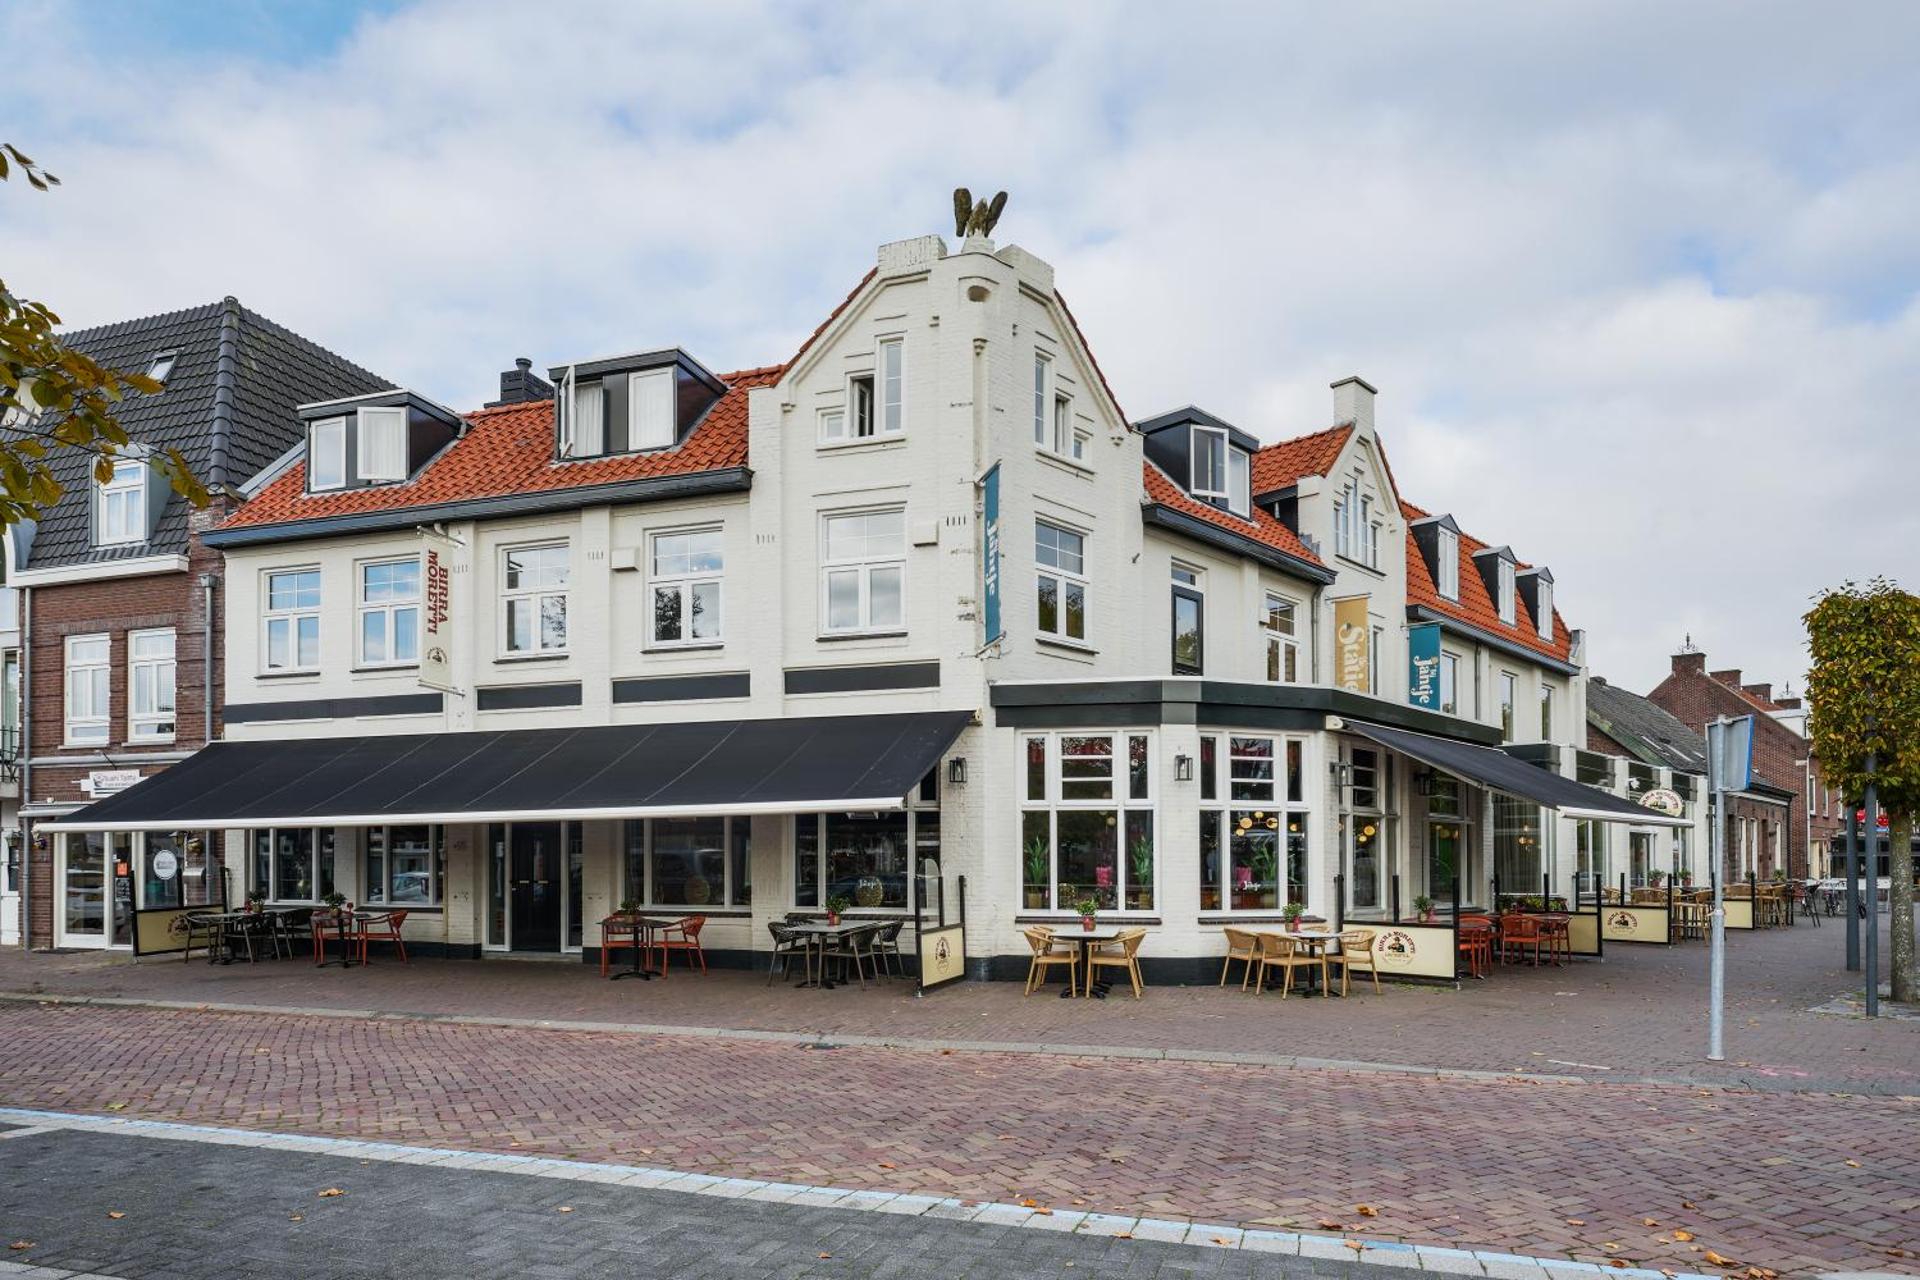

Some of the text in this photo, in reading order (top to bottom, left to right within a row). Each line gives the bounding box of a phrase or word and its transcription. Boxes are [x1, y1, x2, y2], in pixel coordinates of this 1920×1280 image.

[427, 548, 439, 635] MORETTI
[438, 565, 449, 624] BIRRA
[1410, 655, 1434, 704] Jantje
